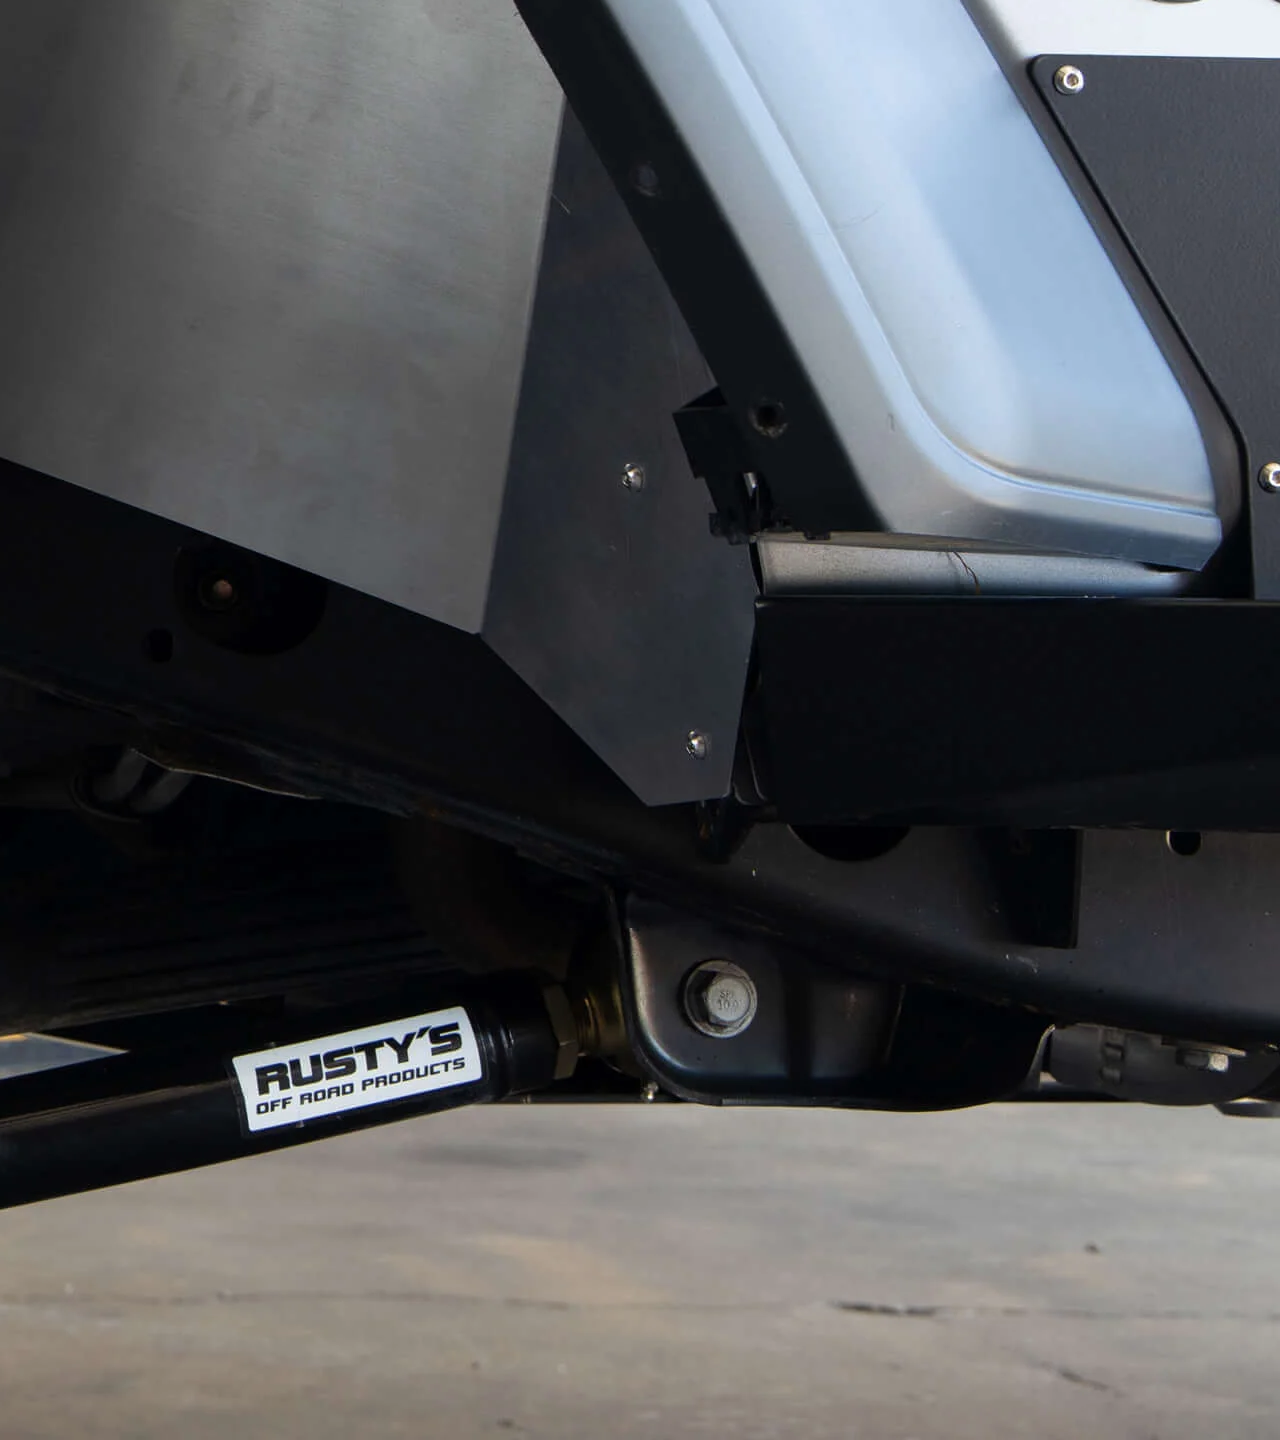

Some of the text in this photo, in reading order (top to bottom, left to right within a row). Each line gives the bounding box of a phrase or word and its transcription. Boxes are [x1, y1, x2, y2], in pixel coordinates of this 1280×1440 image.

[255, 1022, 462, 1096] RUSTY'S
[256, 1057, 466, 1115] OFF ROAD PRODUCTS
